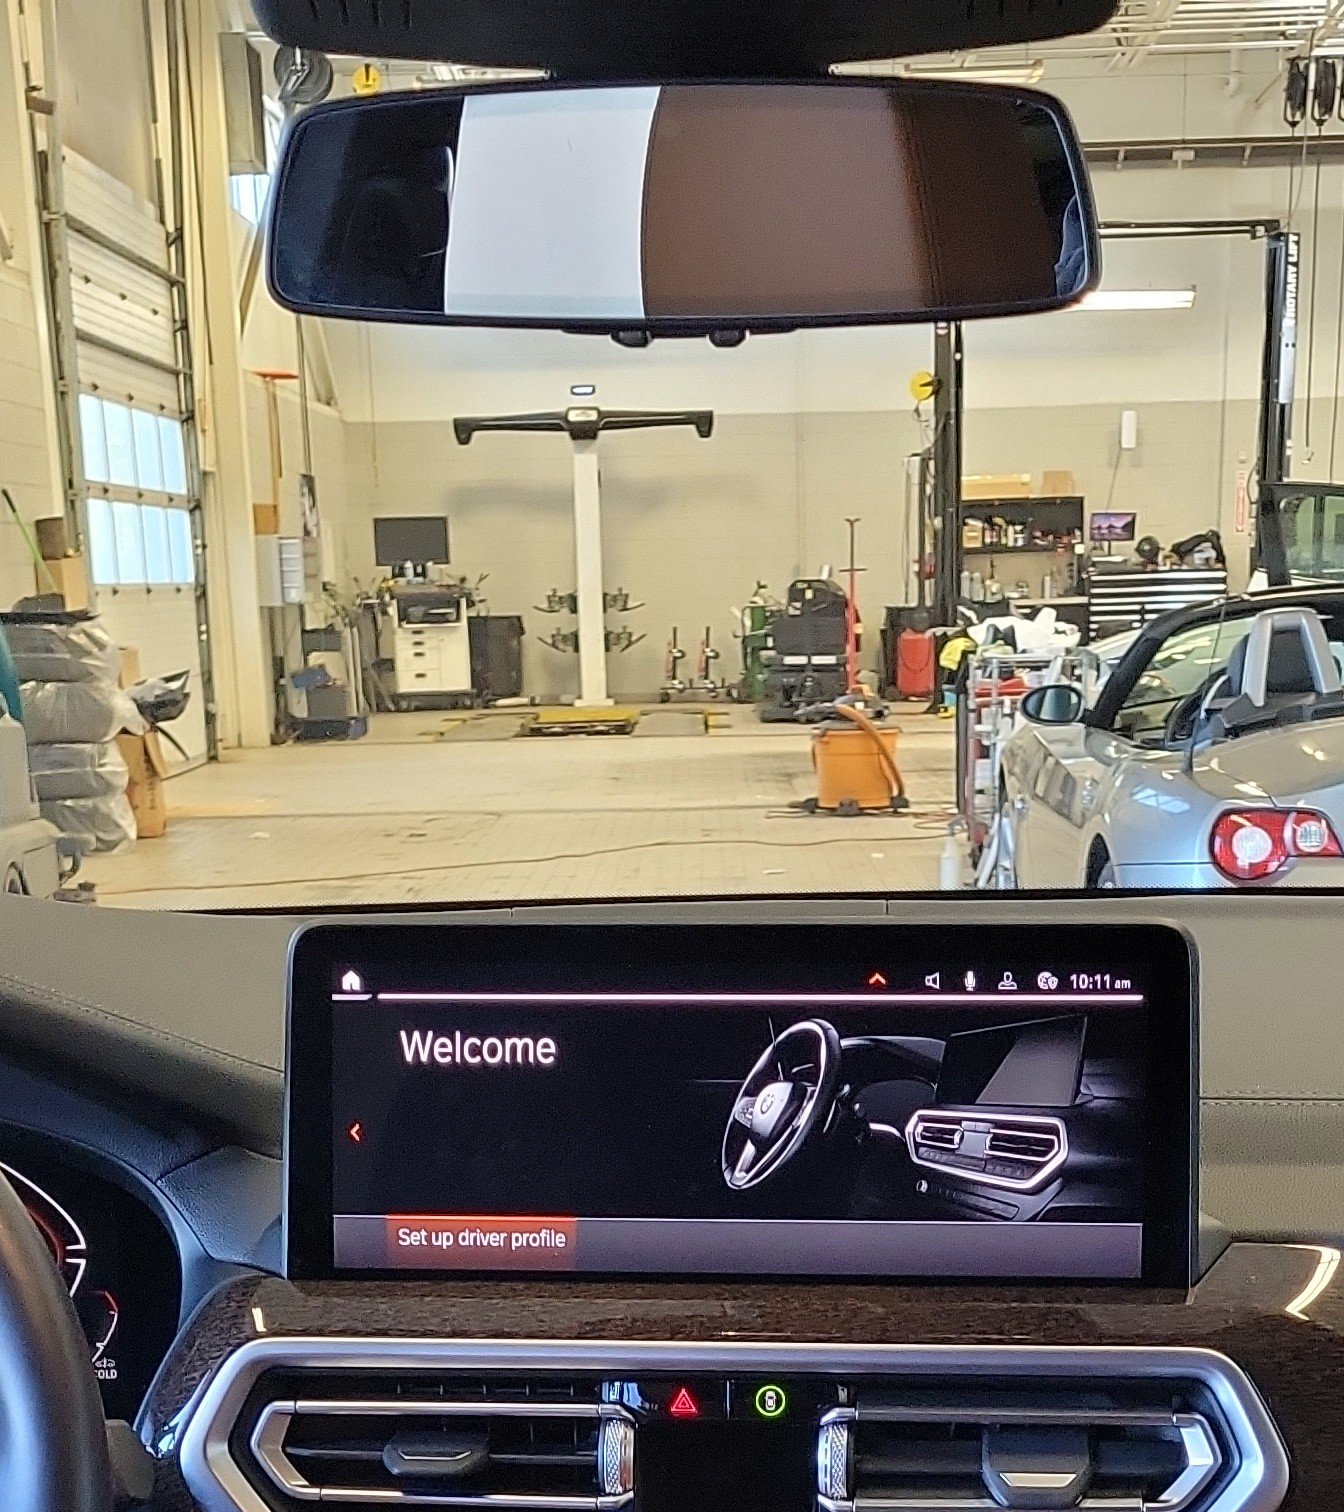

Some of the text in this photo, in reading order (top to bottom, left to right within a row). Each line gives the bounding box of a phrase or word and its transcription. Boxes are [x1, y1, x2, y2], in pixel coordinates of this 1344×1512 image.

[1070, 974, 1132, 989] 10:11 am
[400, 1029, 556, 1066] Welcome
[398, 1228, 567, 1250] Set up driver profile
